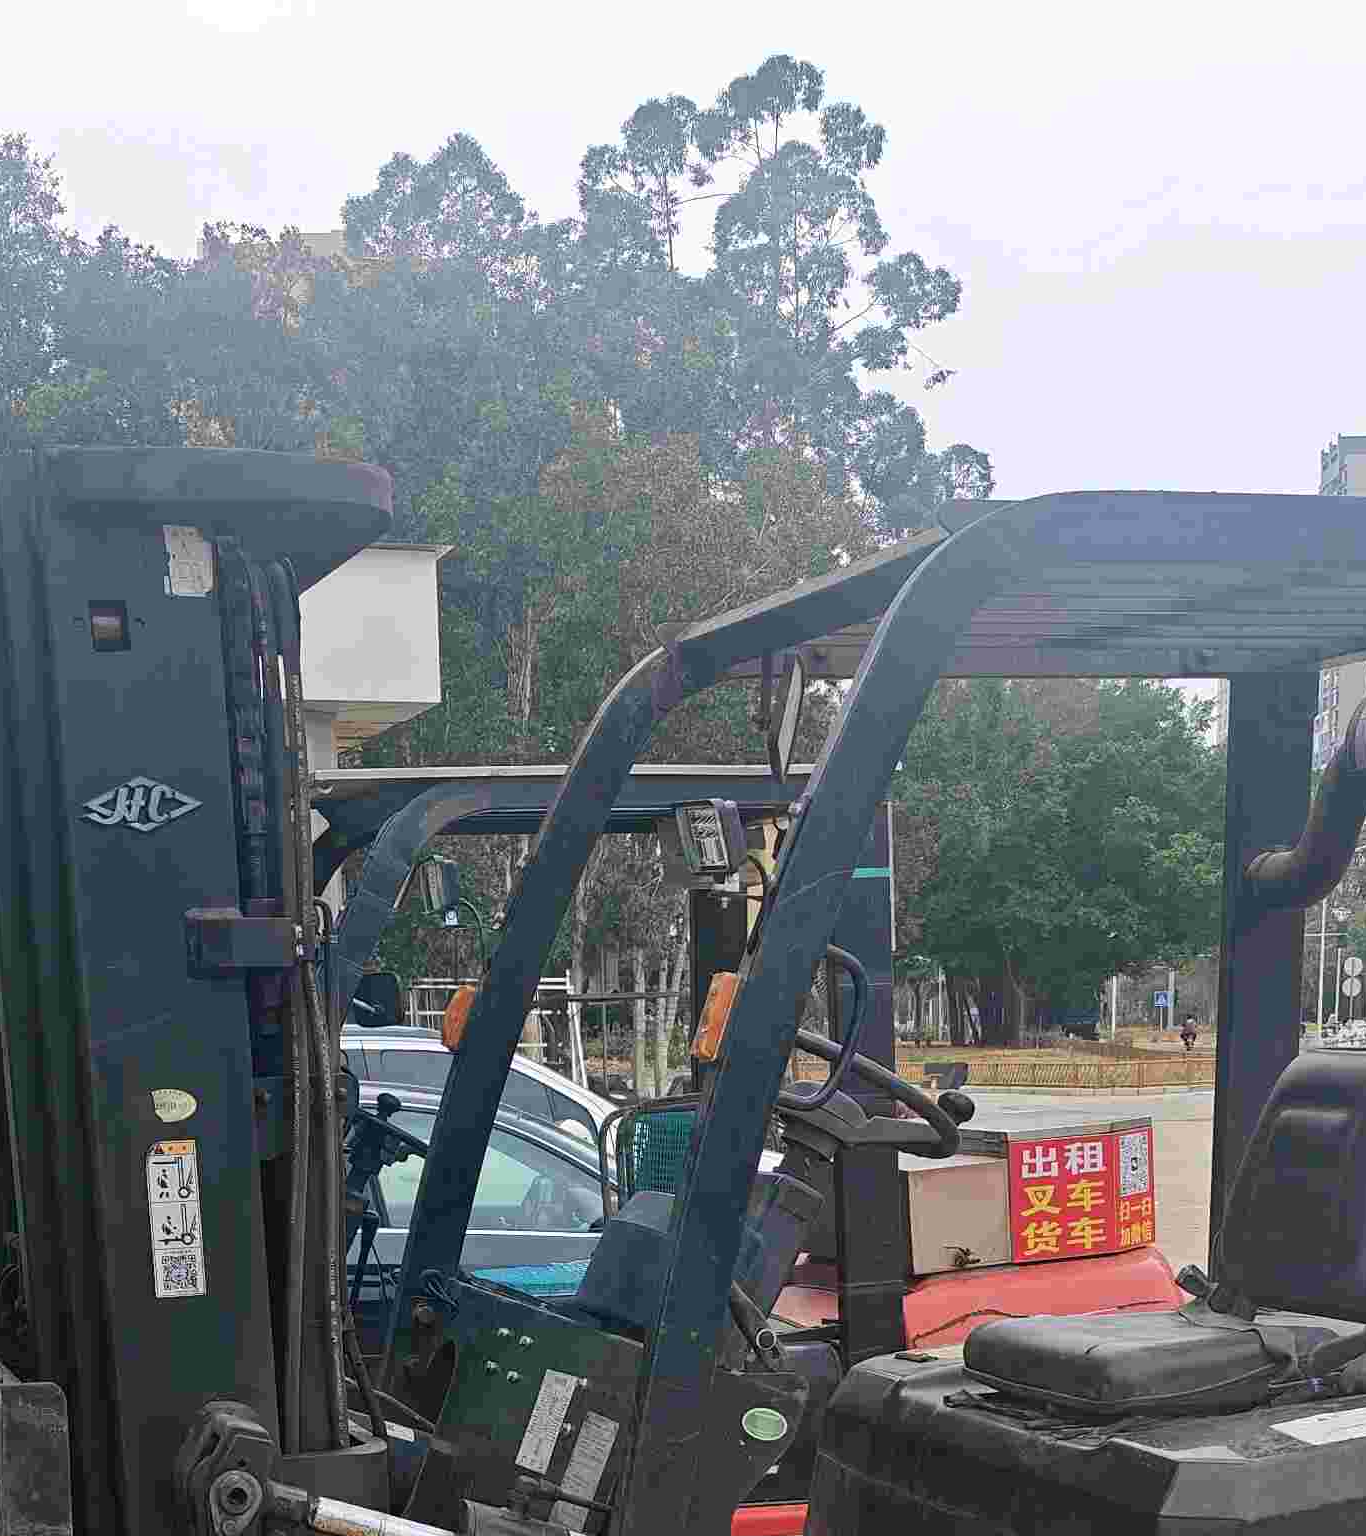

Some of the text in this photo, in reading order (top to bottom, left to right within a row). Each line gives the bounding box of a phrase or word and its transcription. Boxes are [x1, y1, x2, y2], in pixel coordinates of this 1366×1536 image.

[1020, 1141, 1106, 1179] 出租
[1019, 1179, 1106, 1217] 叉车
[1019, 1216, 1106, 1256] 货车
